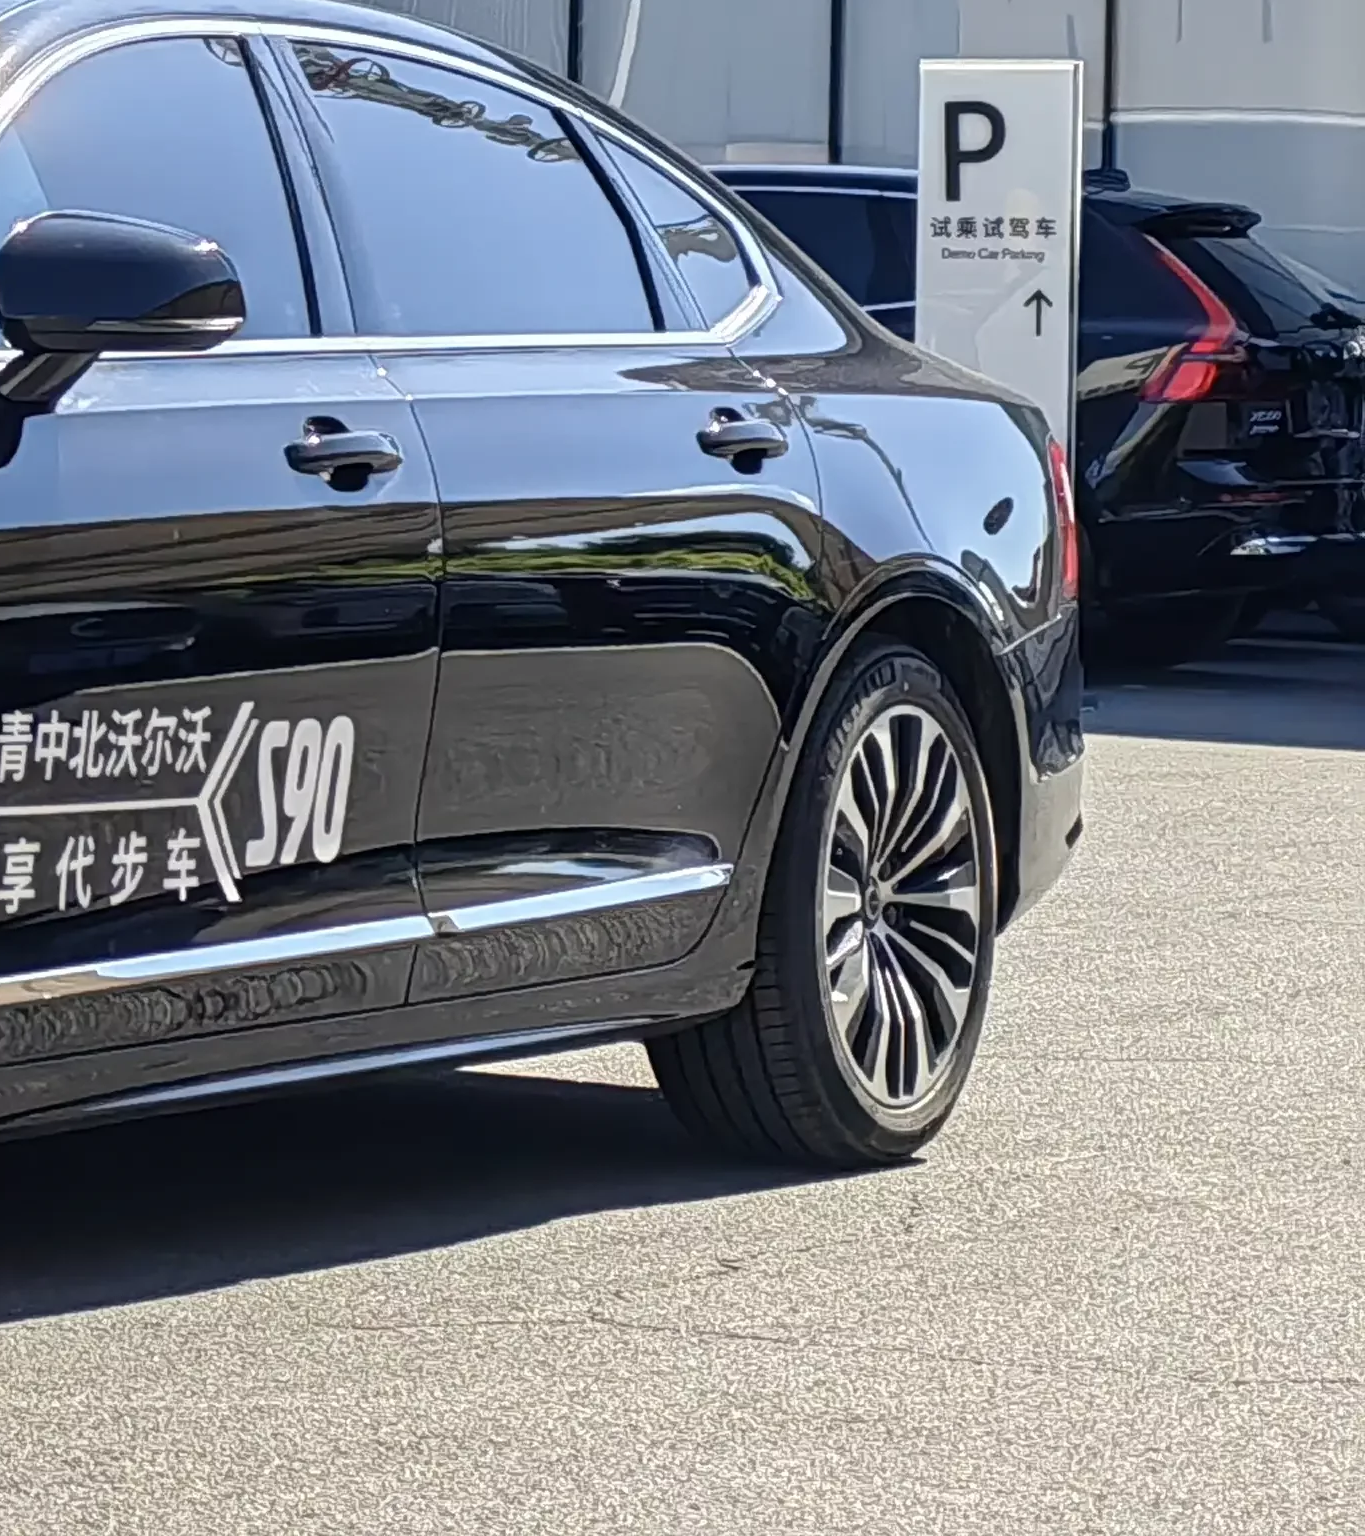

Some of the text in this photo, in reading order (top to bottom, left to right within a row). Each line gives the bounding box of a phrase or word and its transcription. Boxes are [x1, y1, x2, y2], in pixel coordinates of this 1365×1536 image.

[944, 101, 1006, 202] P
[930, 216, 1057, 239] 试乘试驾车
[977, 247, 999, 260] Car
[245, 714, 355, 868] S90
